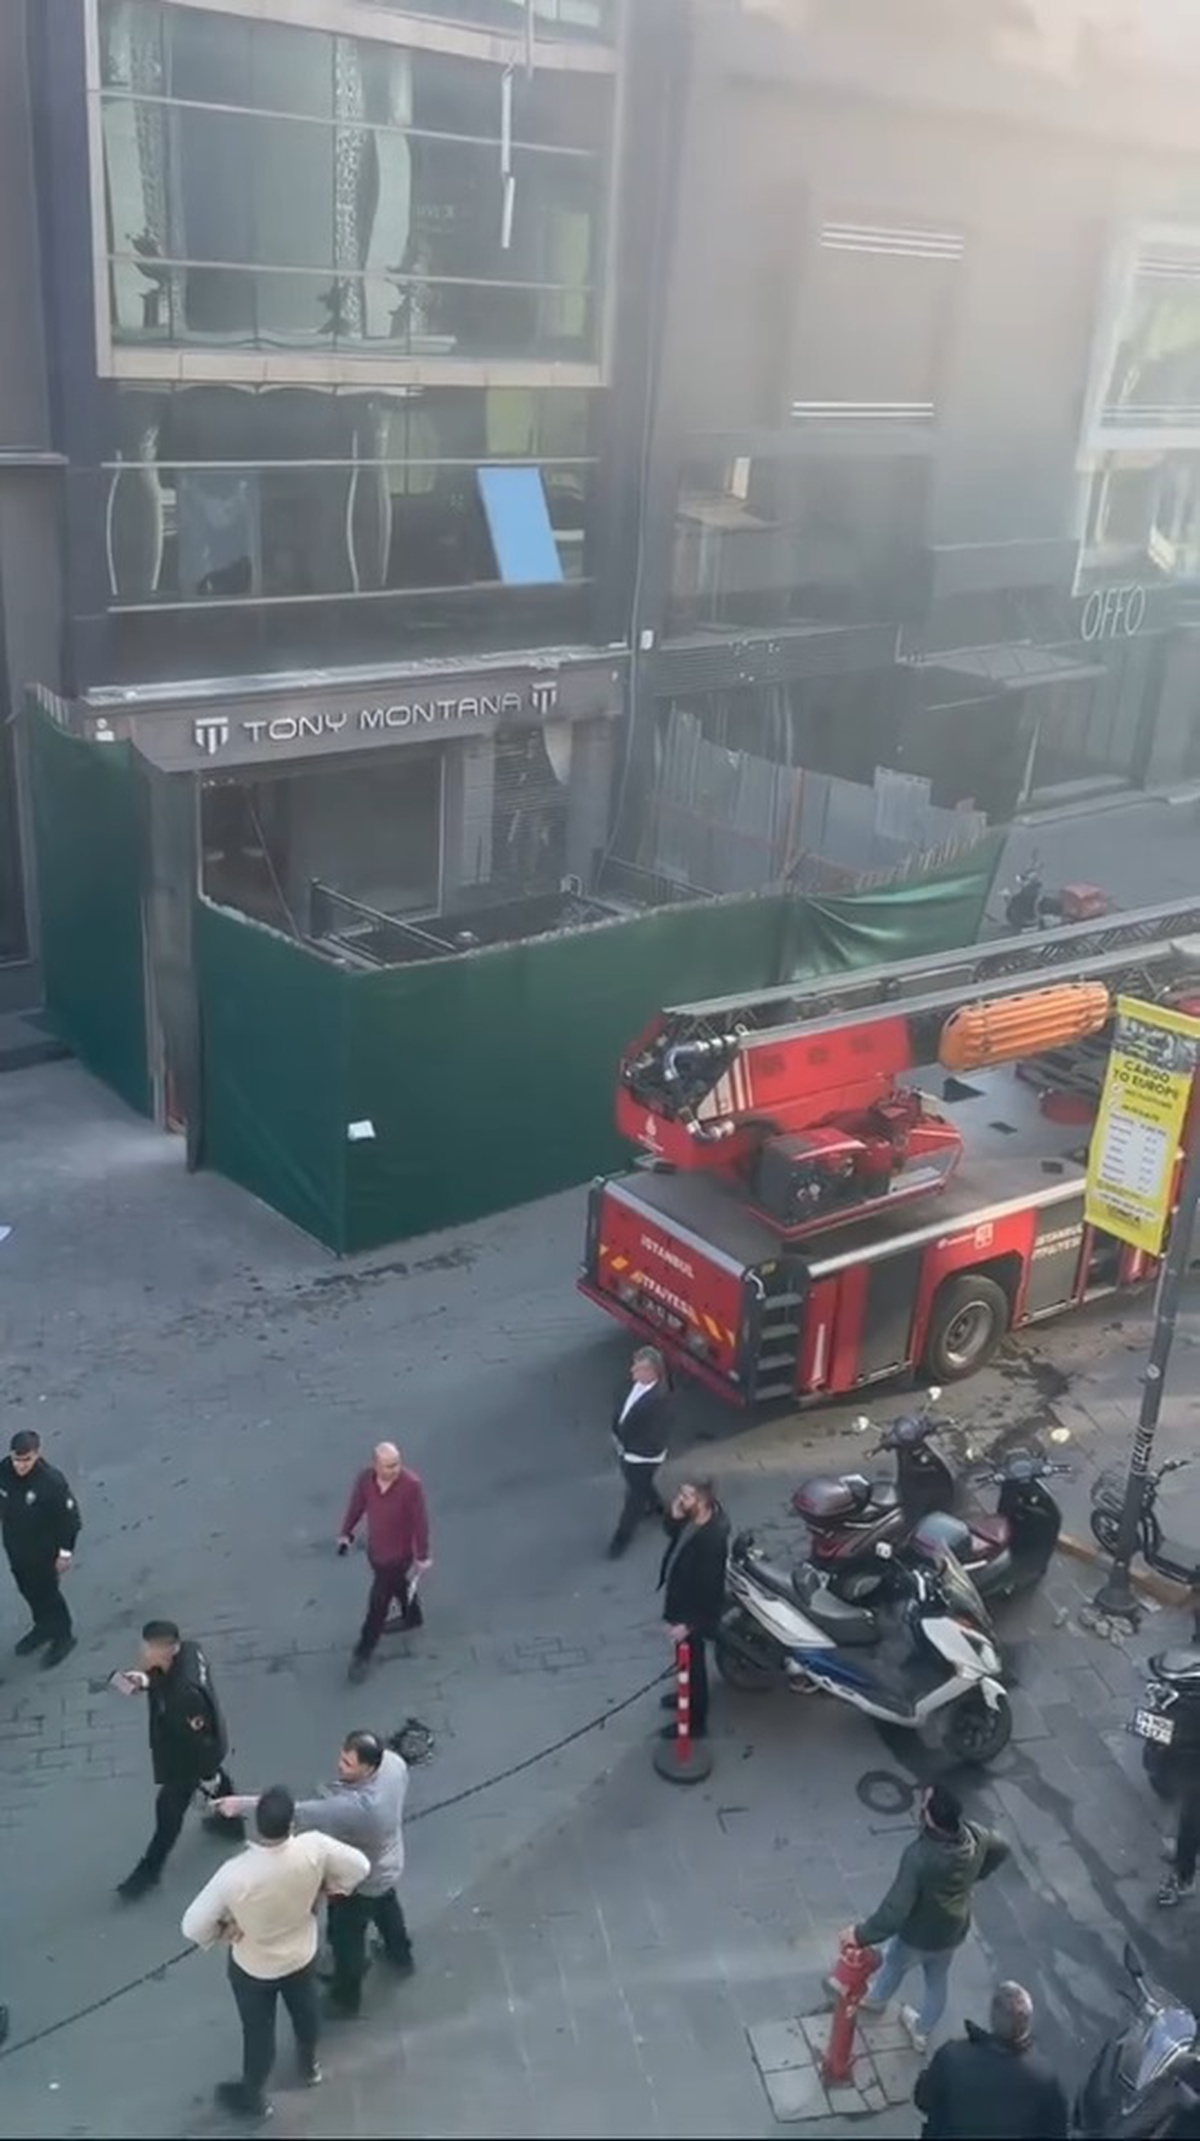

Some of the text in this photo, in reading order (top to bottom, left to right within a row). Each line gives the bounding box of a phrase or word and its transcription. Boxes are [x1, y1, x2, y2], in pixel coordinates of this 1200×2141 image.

[1081, 585, 1146, 641] OFFO
[242, 691, 523, 742] TONY MONTANA
[1112, 1068, 1130, 1083] TO
[1123, 1060, 1171, 1084] CARGO
